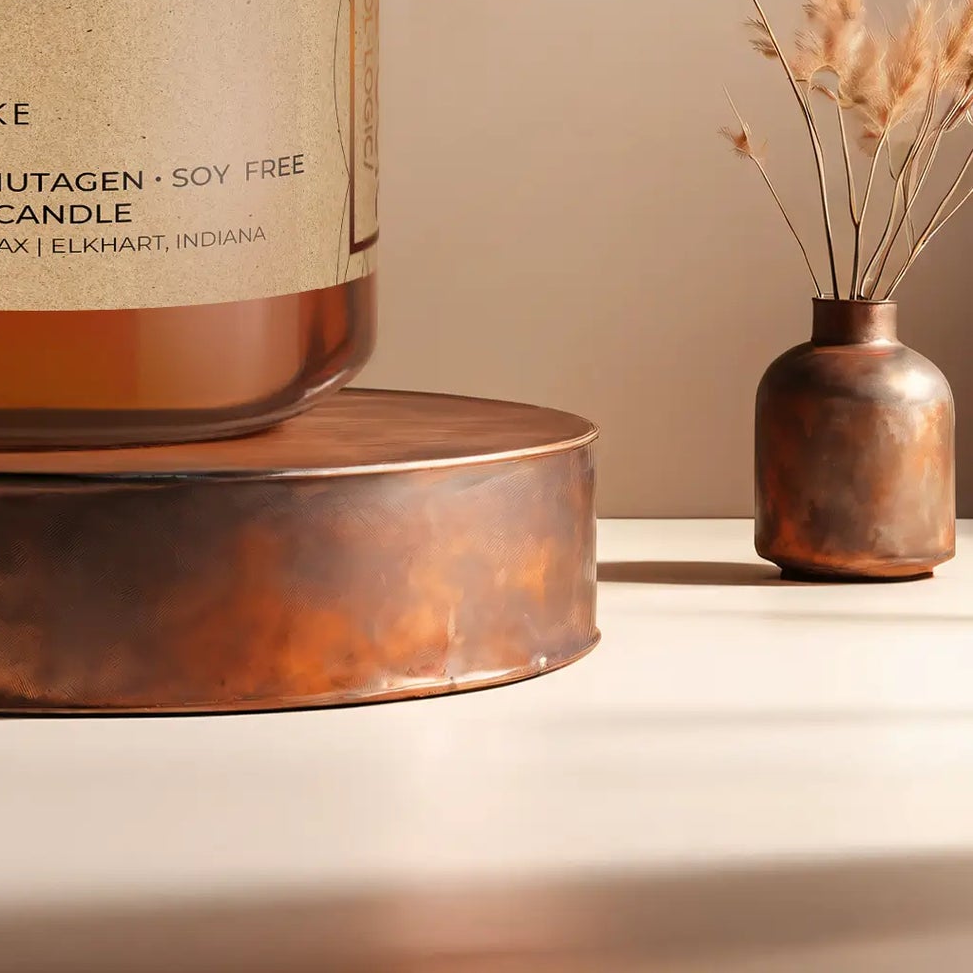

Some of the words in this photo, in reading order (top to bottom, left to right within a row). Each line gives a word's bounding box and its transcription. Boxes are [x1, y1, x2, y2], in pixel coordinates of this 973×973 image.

[171, 163, 231, 189] SOY
[245, 153, 305, 182] FREE
[51, 234, 170, 254] ELKHART,
[176, 226, 266, 250] INDIANA
